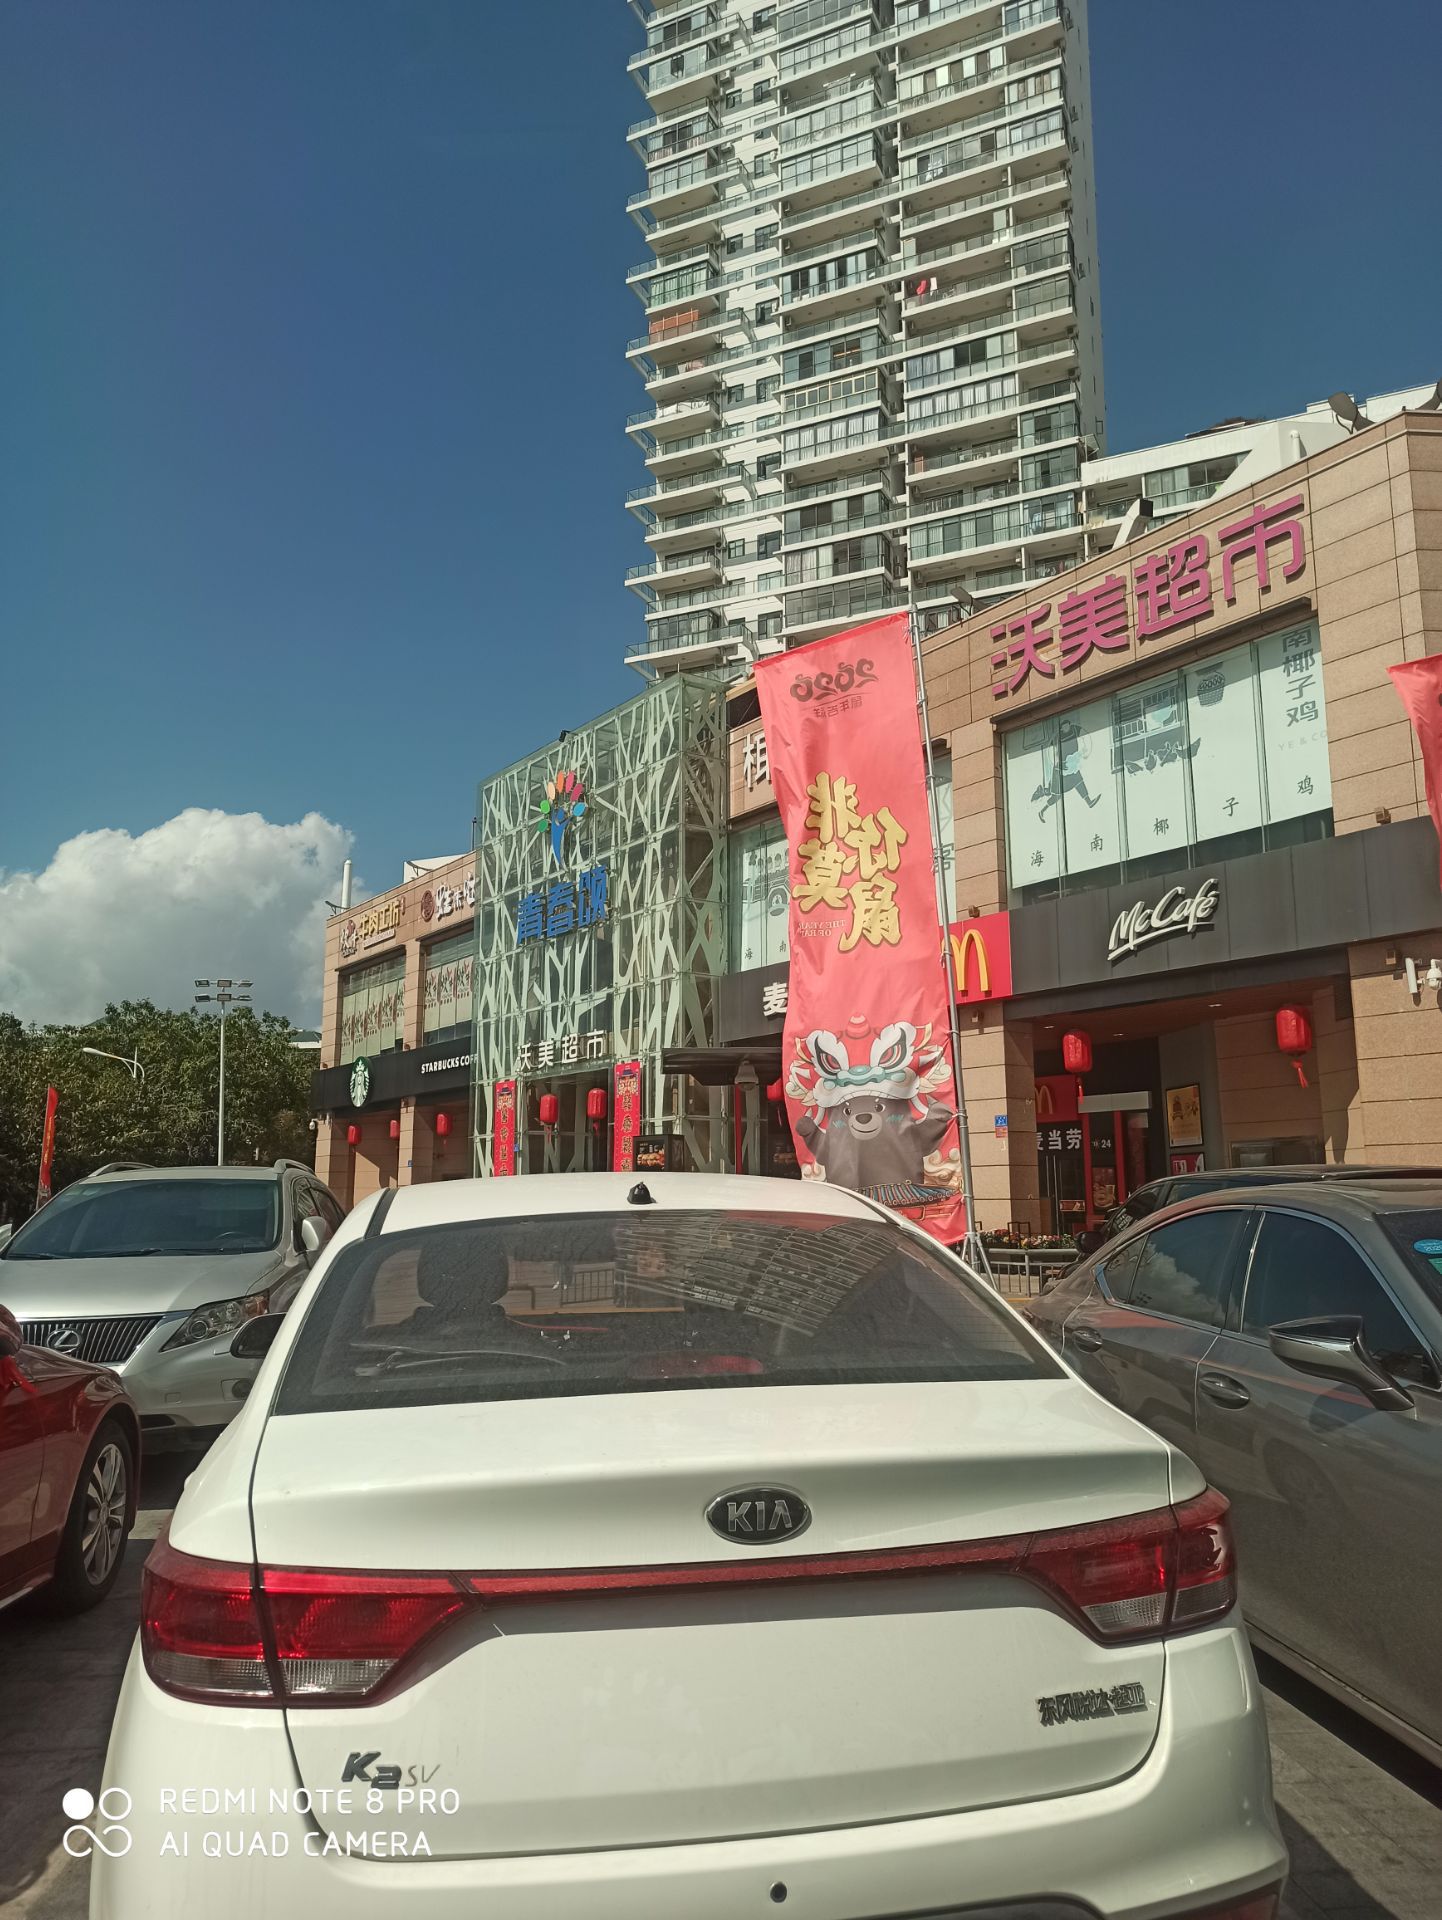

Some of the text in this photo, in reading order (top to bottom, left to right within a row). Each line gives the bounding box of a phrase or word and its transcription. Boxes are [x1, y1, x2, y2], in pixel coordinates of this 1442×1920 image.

[990, 494, 1305, 697] 沃美超市
[517, 864, 608, 945] 青春颂
[1107, 878, 1220, 956] McCafé
[421, 1056, 459, 1074] STARBUCKS
[517, 1028, 605, 1070] 沃美超市
[726, 1500, 793, 1532] KIA
